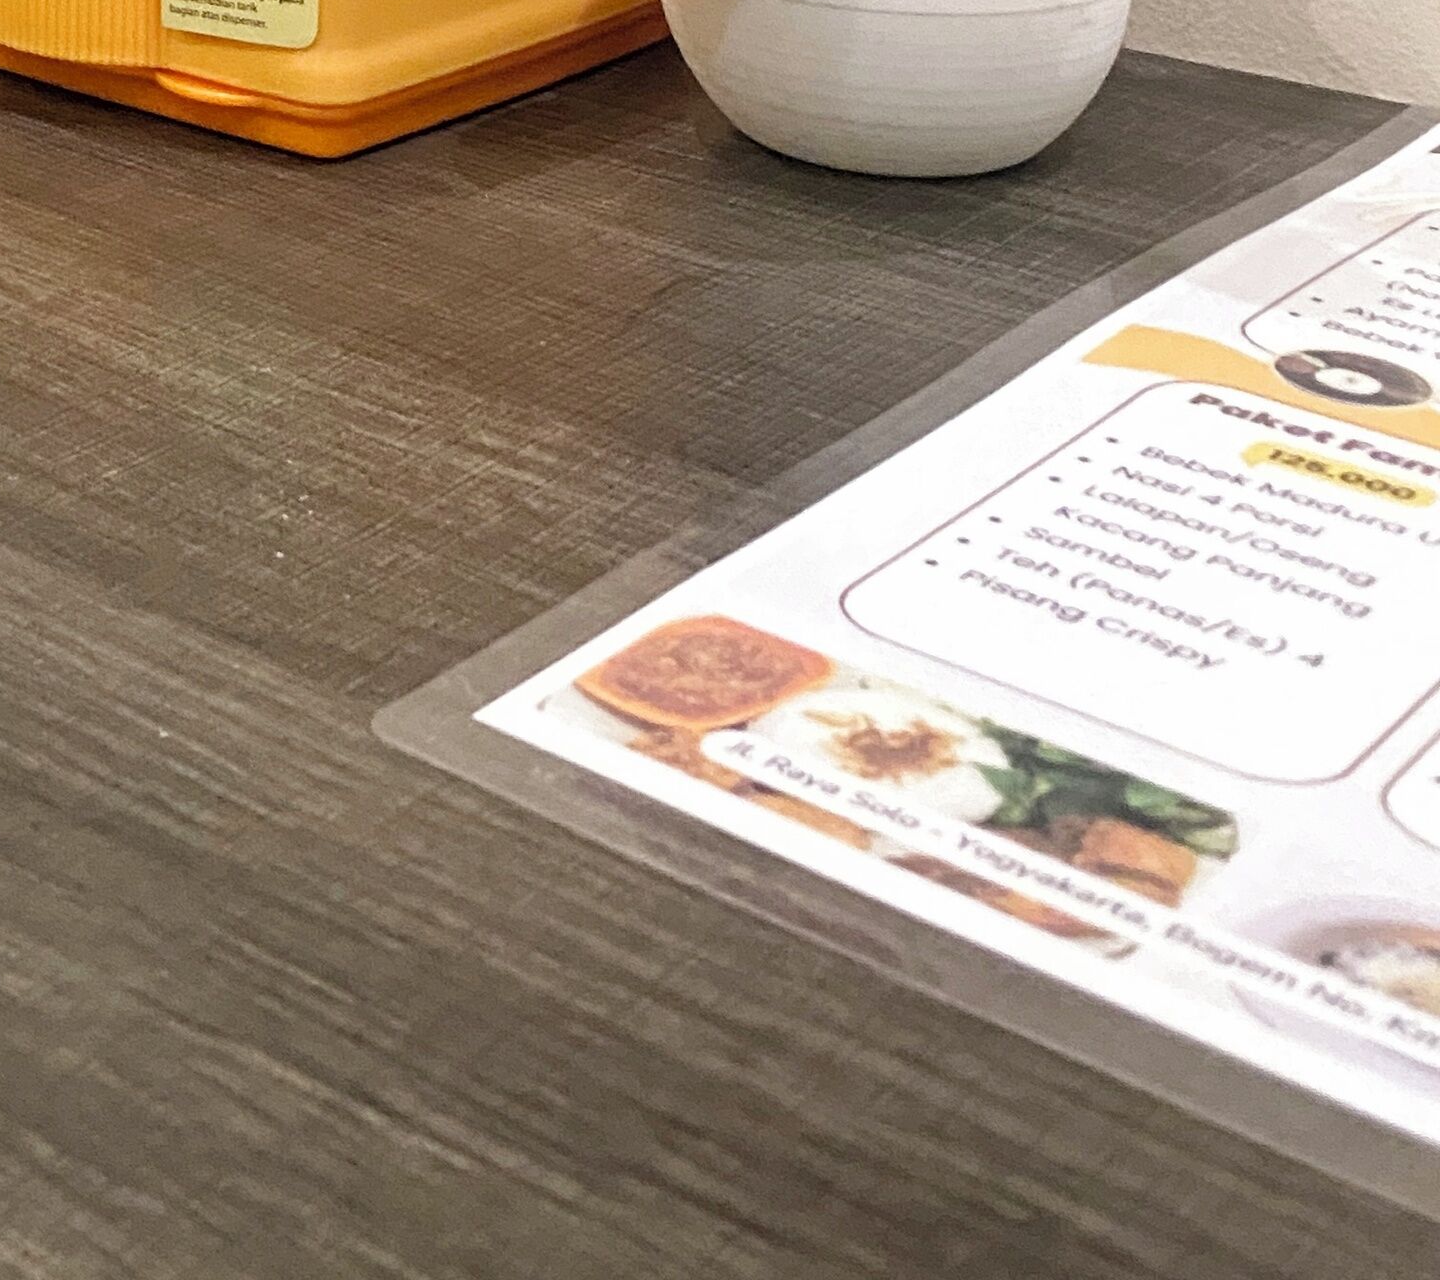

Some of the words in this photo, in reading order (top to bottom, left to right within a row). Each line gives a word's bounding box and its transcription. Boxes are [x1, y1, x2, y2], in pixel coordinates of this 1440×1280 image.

[1189, 392, 1335, 444] Paket
[1083, 485, 1377, 588] Lalapan/Oseng
[1112, 466, 1197, 496] Nasi
[1198, 494, 1224, 506] 4
[1231, 502, 1325, 537] Porsi
[1140, 446, 1250, 486] Bebek
[1257, 482, 1409, 535] Madura
[1024, 526, 1172, 581] Sambel
[1054, 506, 1198, 561] Kacang
[1206, 553, 1373, 619] Panjang
[960, 569, 1088, 624] Pisang
[1095, 616, 1227, 670] Crispy
[997, 548, 1060, 578] Teh
[1069, 572, 1288, 656] (Panas/Es)
[1298, 653, 1325, 669] 4
[763, 754, 841, 796] Raya
[847, 790, 921, 829] Solo
[957, 831, 1152, 932] Yogyakarta,
[1164, 919, 1298, 990] Bogem
